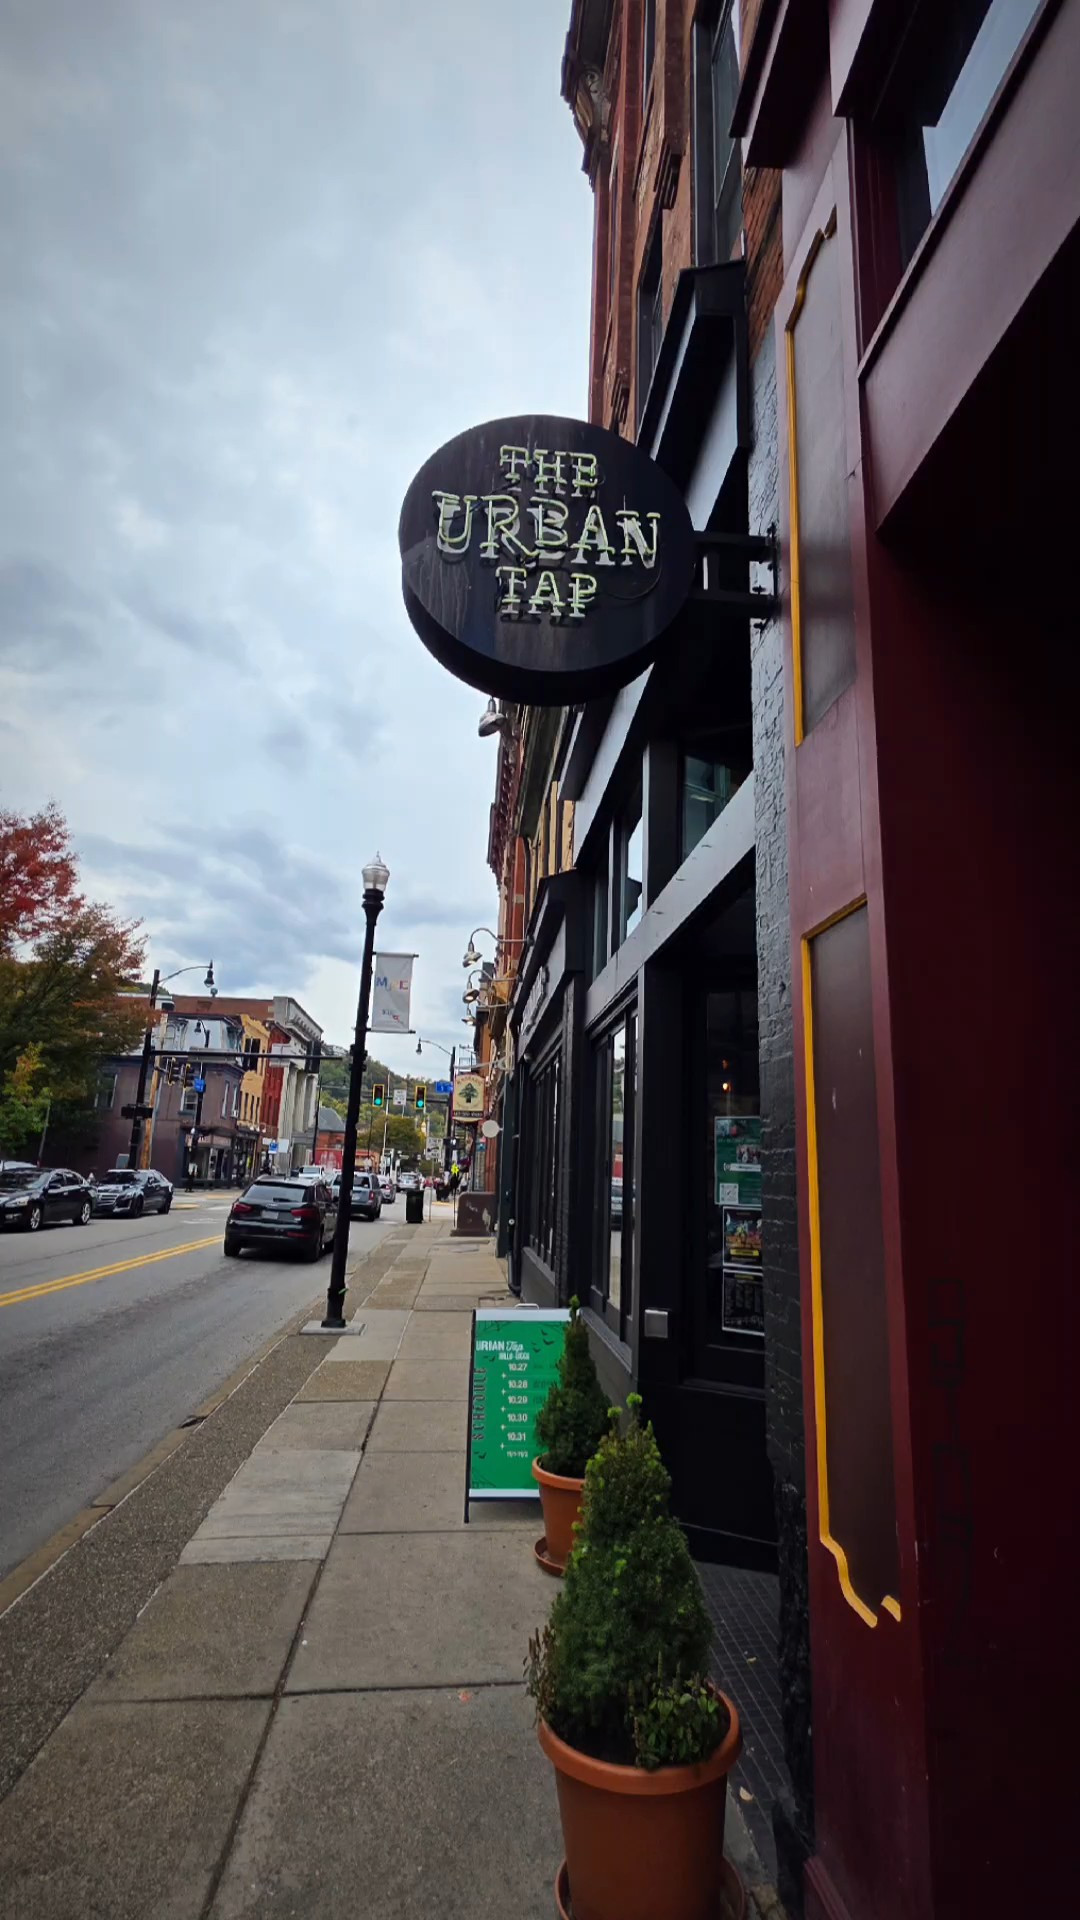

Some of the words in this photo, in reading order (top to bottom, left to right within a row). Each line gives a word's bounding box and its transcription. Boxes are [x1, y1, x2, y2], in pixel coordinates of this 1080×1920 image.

[500, 445, 598, 497] THE
[431, 490, 661, 568] URBAN
[495, 566, 598, 618] TAP
[508, 1363, 528, 1371] 10.27
